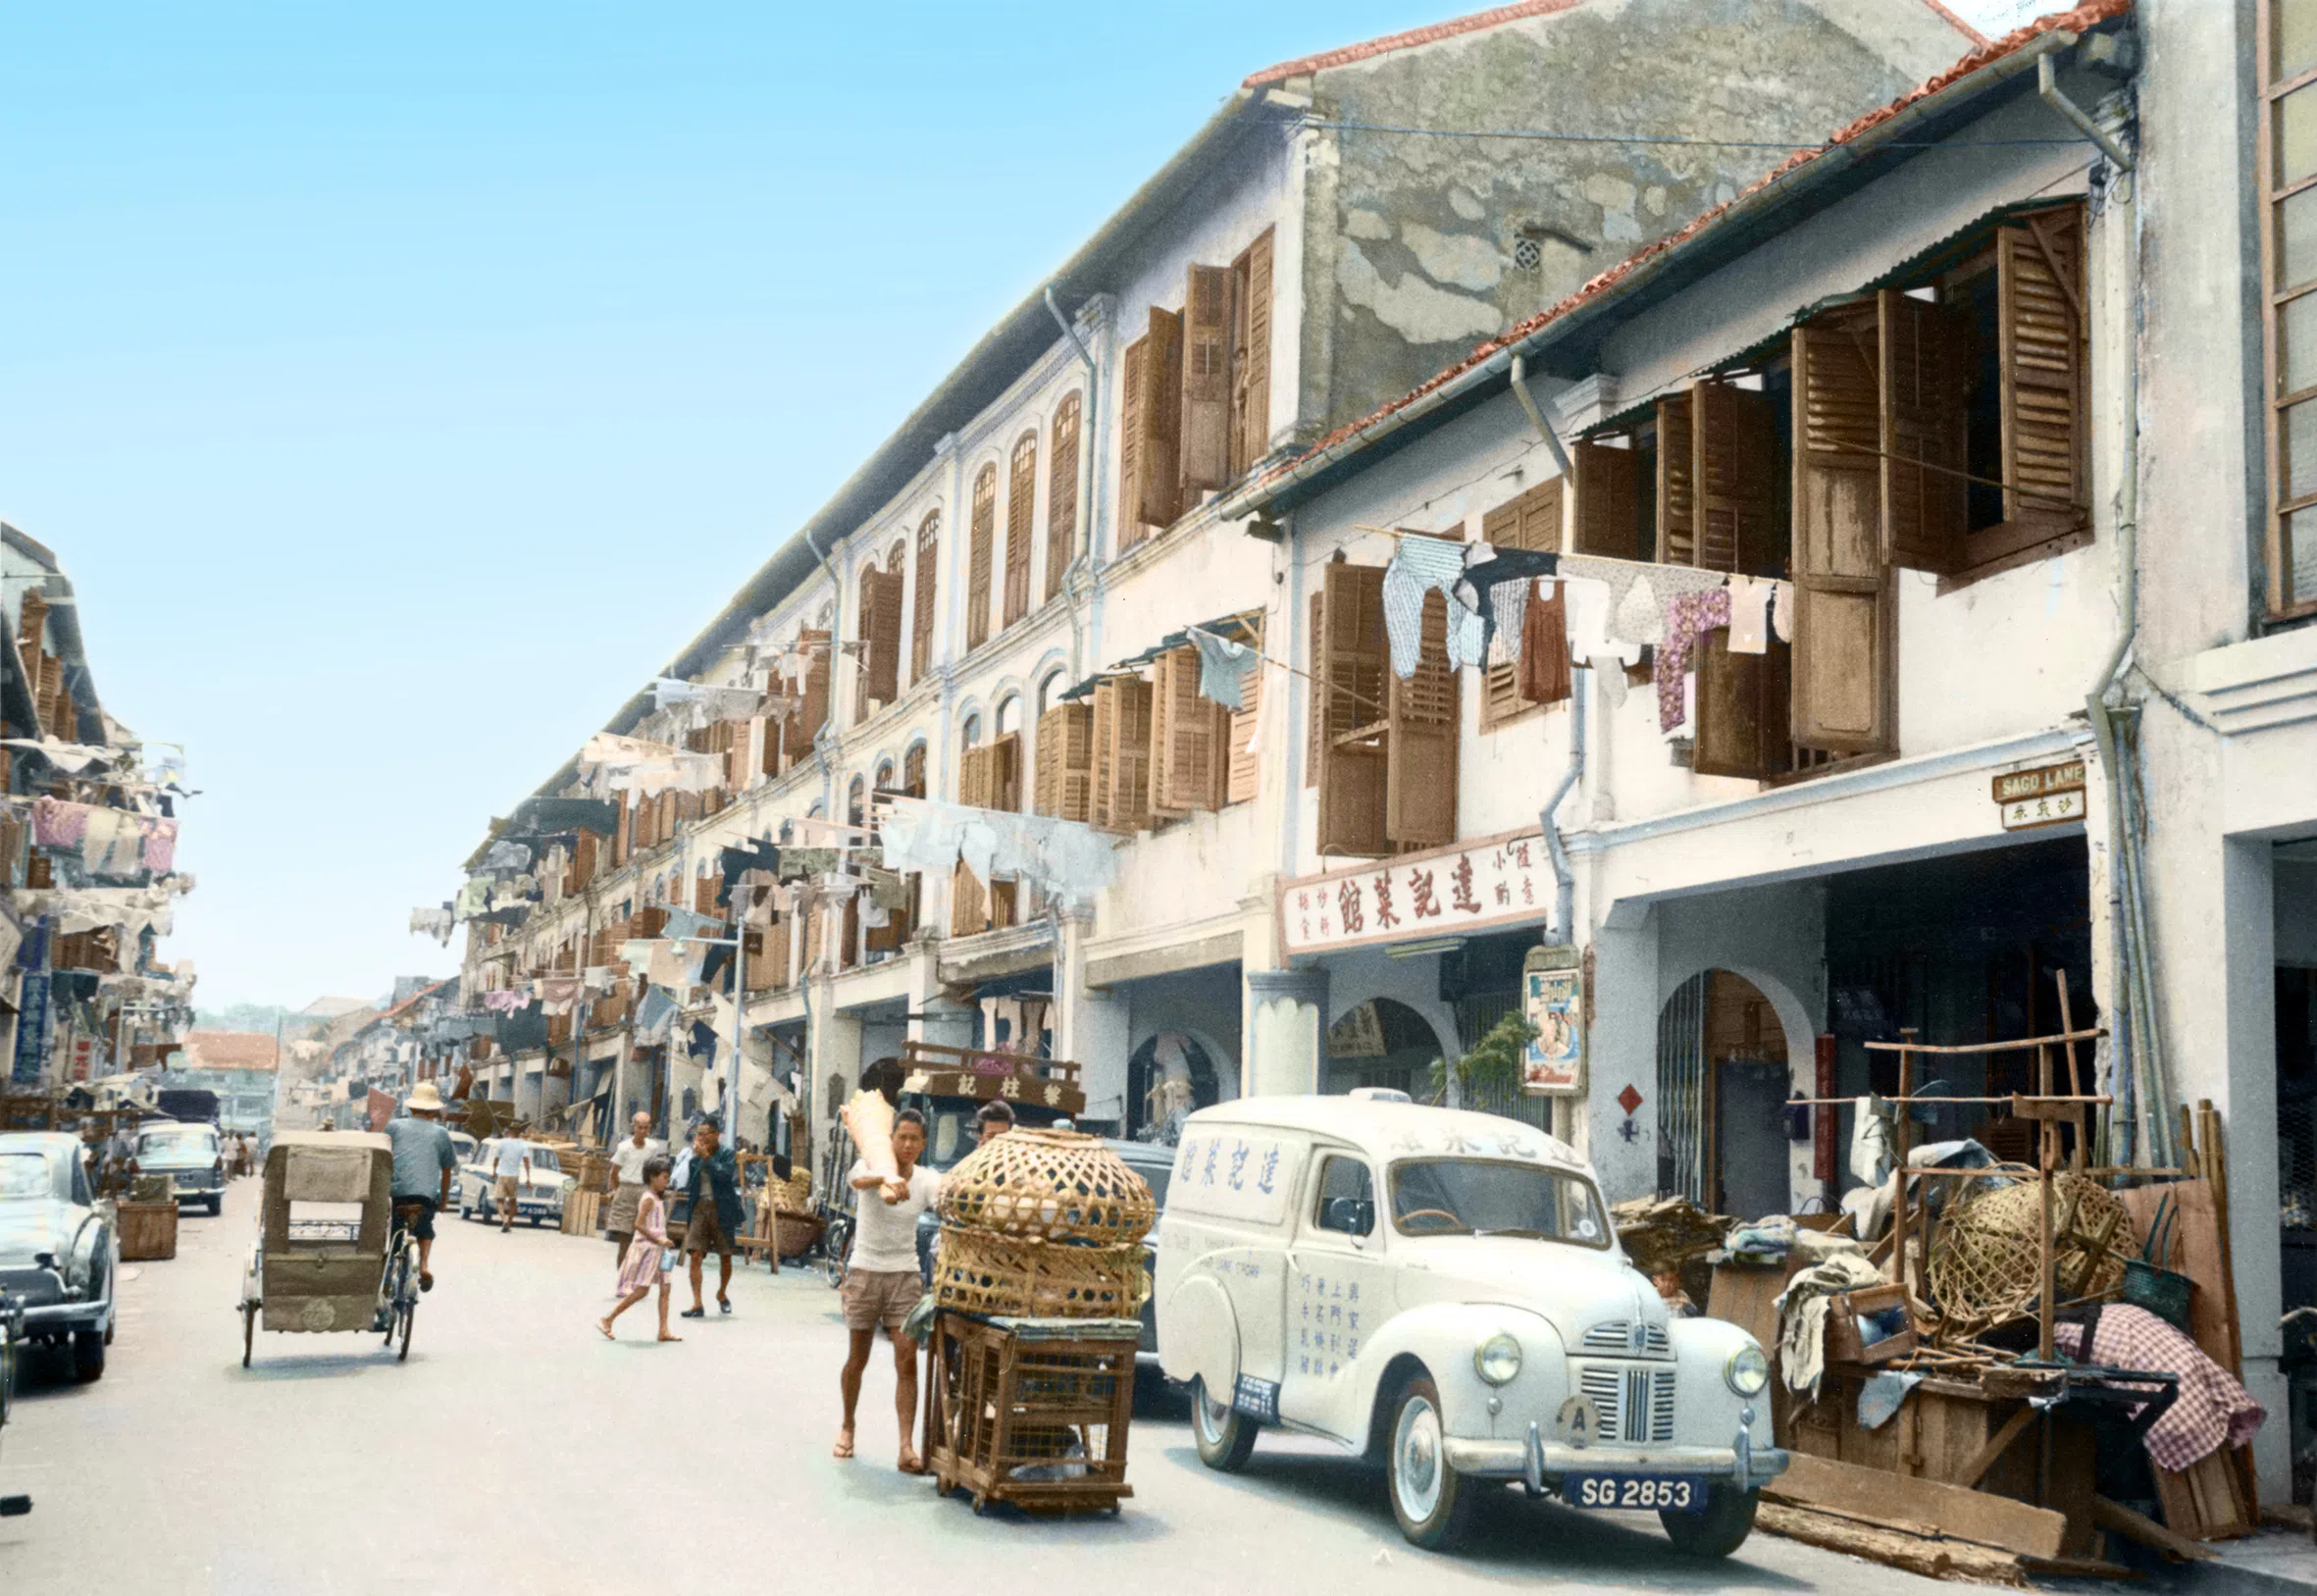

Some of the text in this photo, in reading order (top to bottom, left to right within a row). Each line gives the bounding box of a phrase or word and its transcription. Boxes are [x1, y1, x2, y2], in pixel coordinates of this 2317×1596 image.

[2002, 766, 2085, 798] SAGO LANE
[1581, 1478, 1691, 1508] SG 2853
